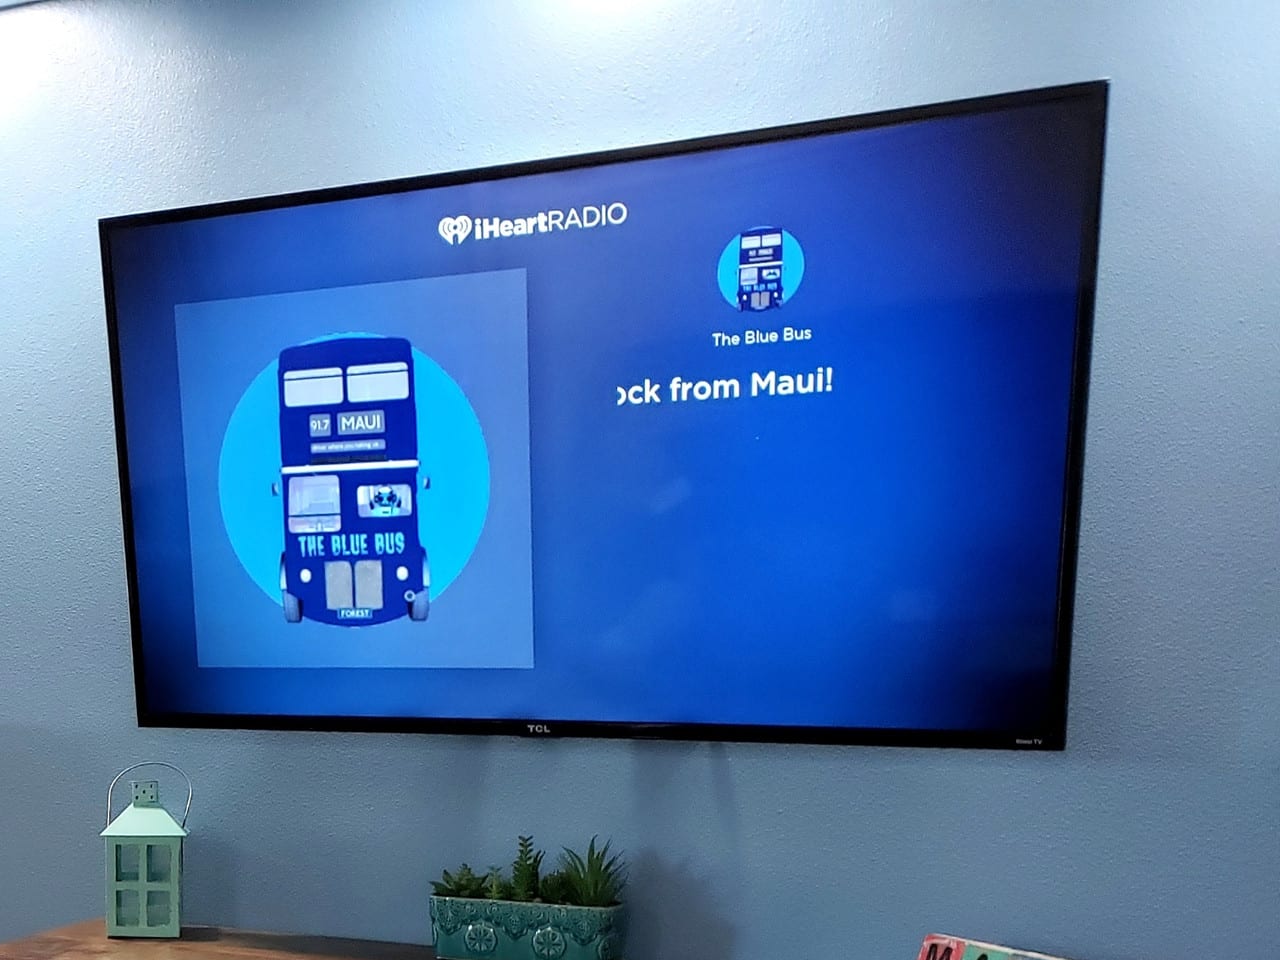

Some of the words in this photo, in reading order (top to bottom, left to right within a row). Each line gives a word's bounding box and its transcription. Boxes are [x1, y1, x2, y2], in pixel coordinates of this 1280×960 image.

[474, 202, 628, 241] iHeartRADIO
[712, 332, 741, 346] The
[745, 330, 778, 344] Blue
[783, 327, 812, 341] Bus
[670, 377, 740, 402] from
[750, 367, 833, 398] Maui!
[341, 414, 381, 431] MAUI
[298, 535, 325, 558] THE
[331, 533, 368, 556] BLUE
[374, 531, 405, 554] BUS
[527, 724, 551, 733] TCL
